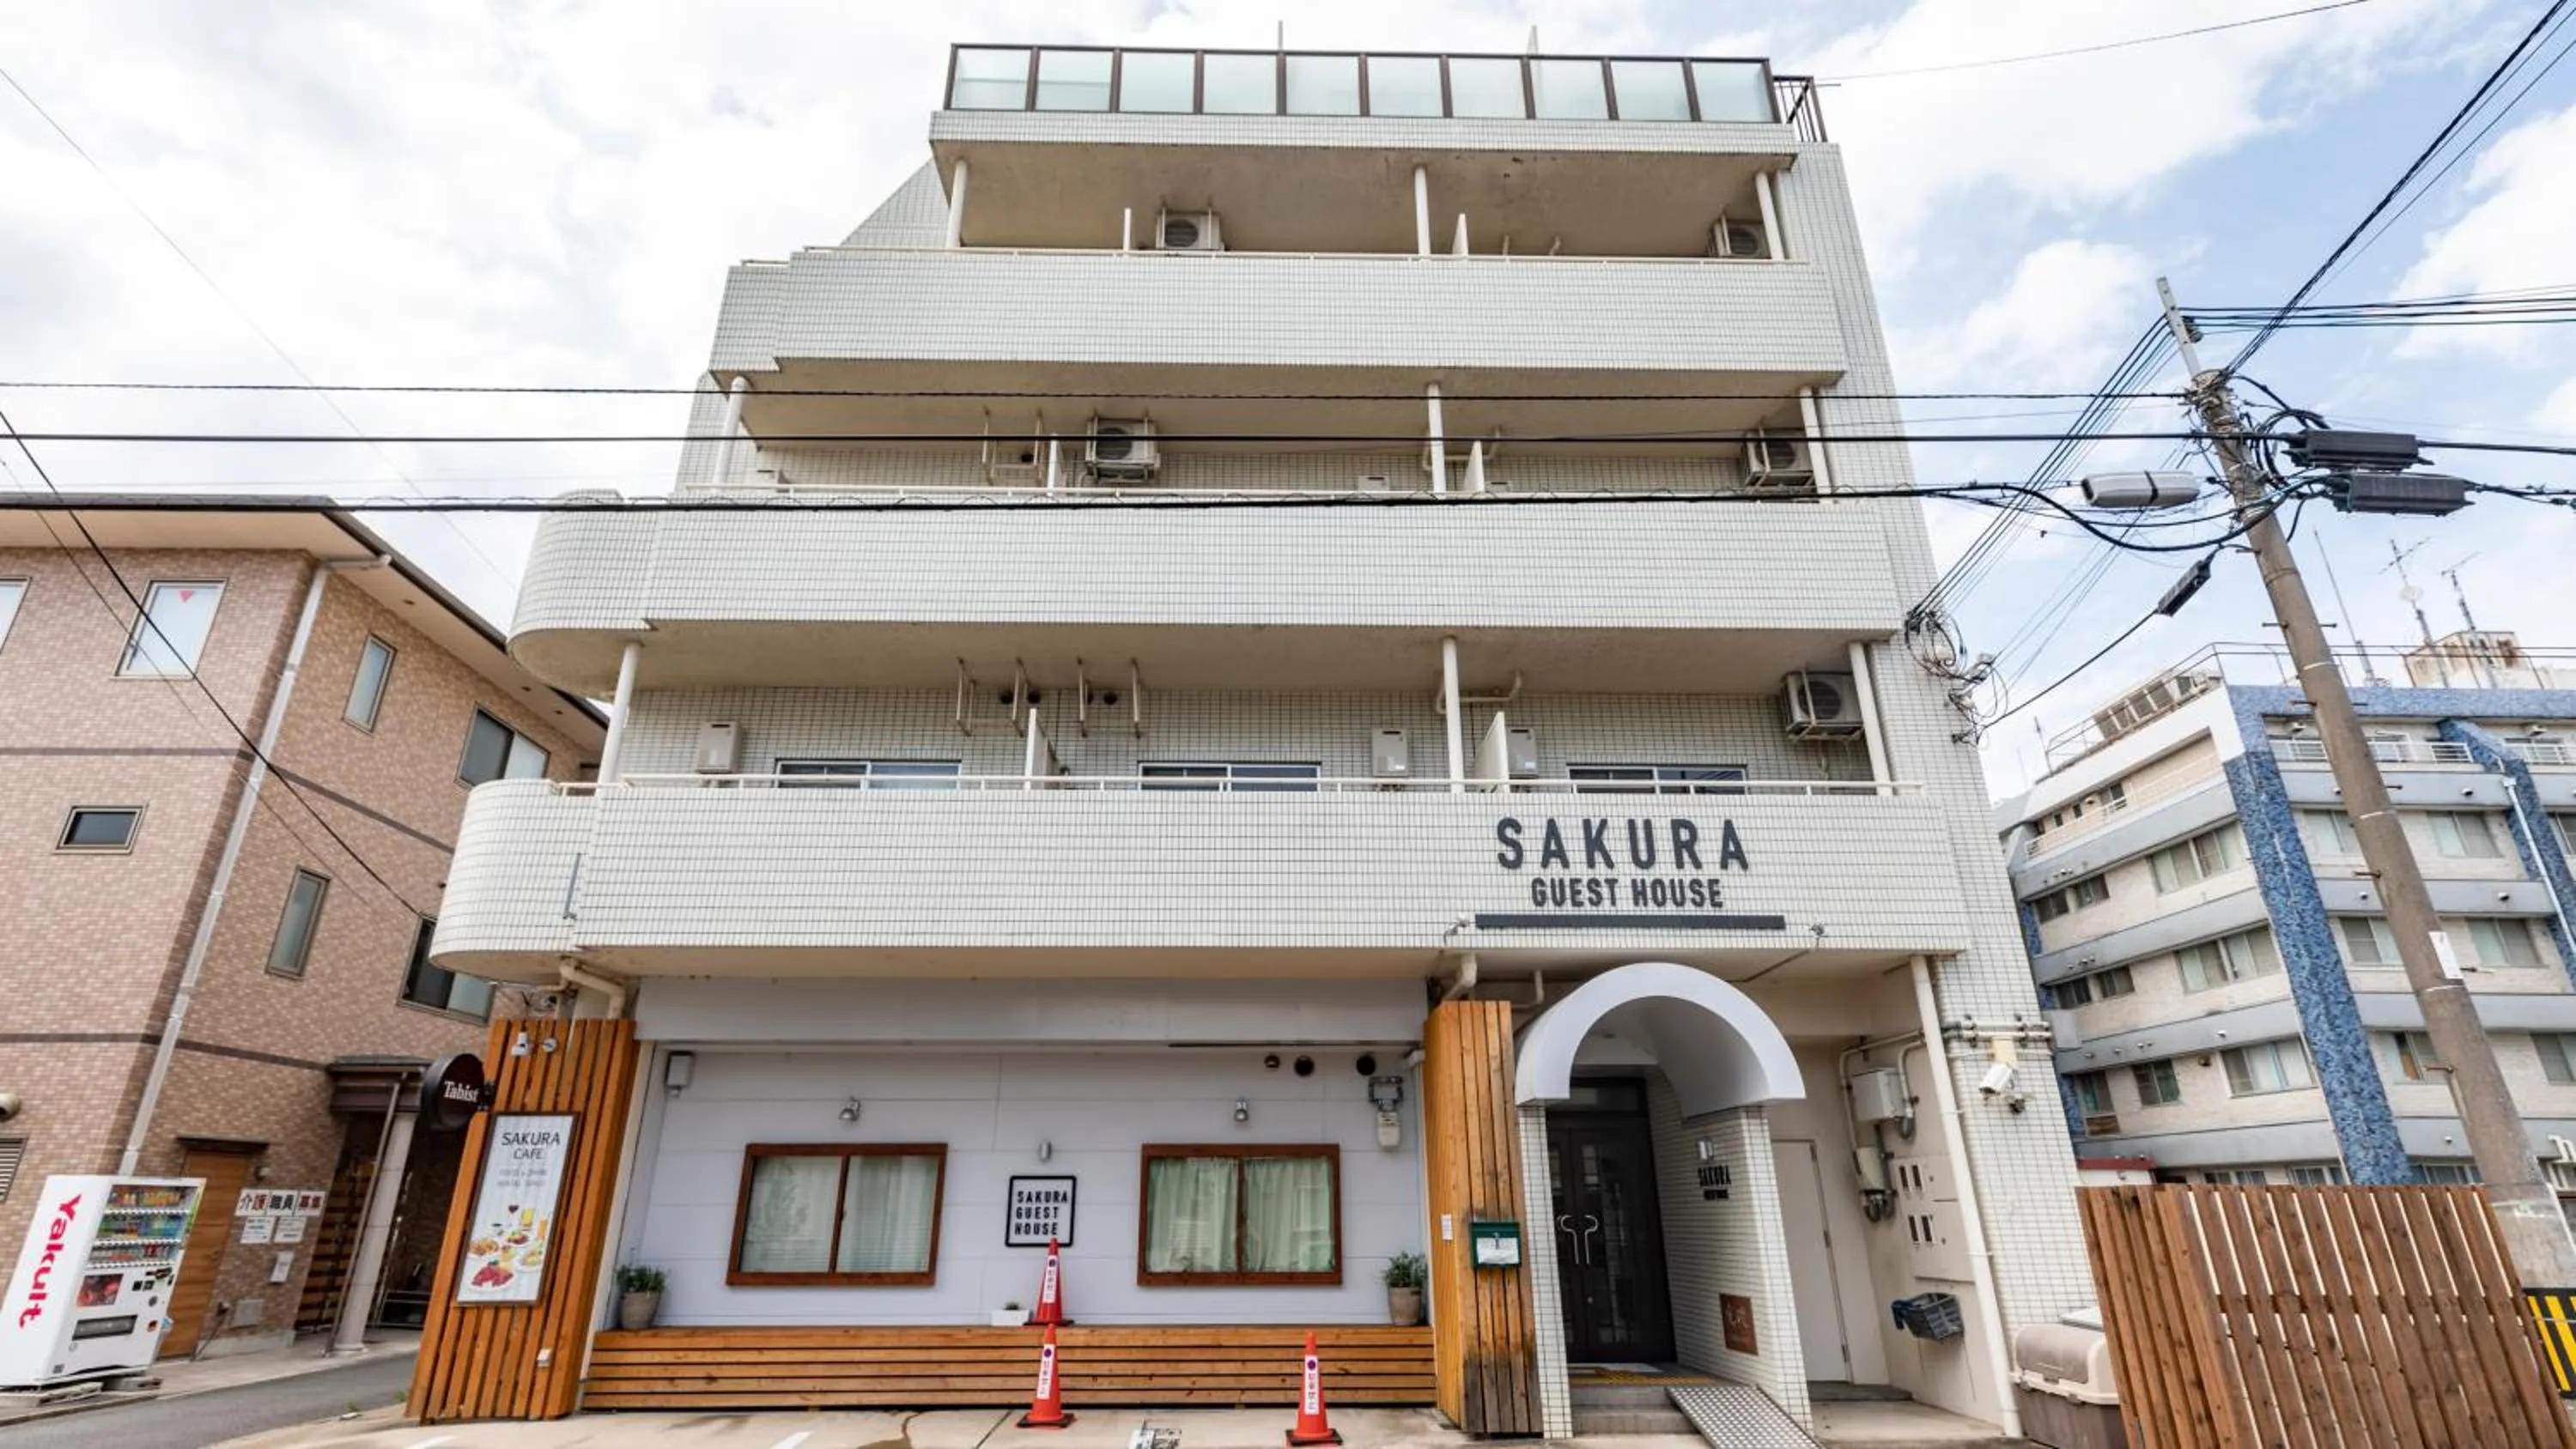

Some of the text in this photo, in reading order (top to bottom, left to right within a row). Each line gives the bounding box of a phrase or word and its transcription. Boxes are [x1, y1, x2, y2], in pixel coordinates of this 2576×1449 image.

[1497, 816, 1749, 871] SAKURA
[1531, 877, 1723, 908] GUEST HOUSE
[444, 1081, 479, 1103] Tabist
[501, 1131, 561, 1146] SAKURA
[513, 1148, 544, 1160] CAFE
[1017, 1191, 1068, 1203] SAKURA
[1016, 1206, 1059, 1219] GUEST
[1015, 1222, 1058, 1235] HOUSE
[19, 1193, 82, 1330] Yakult
